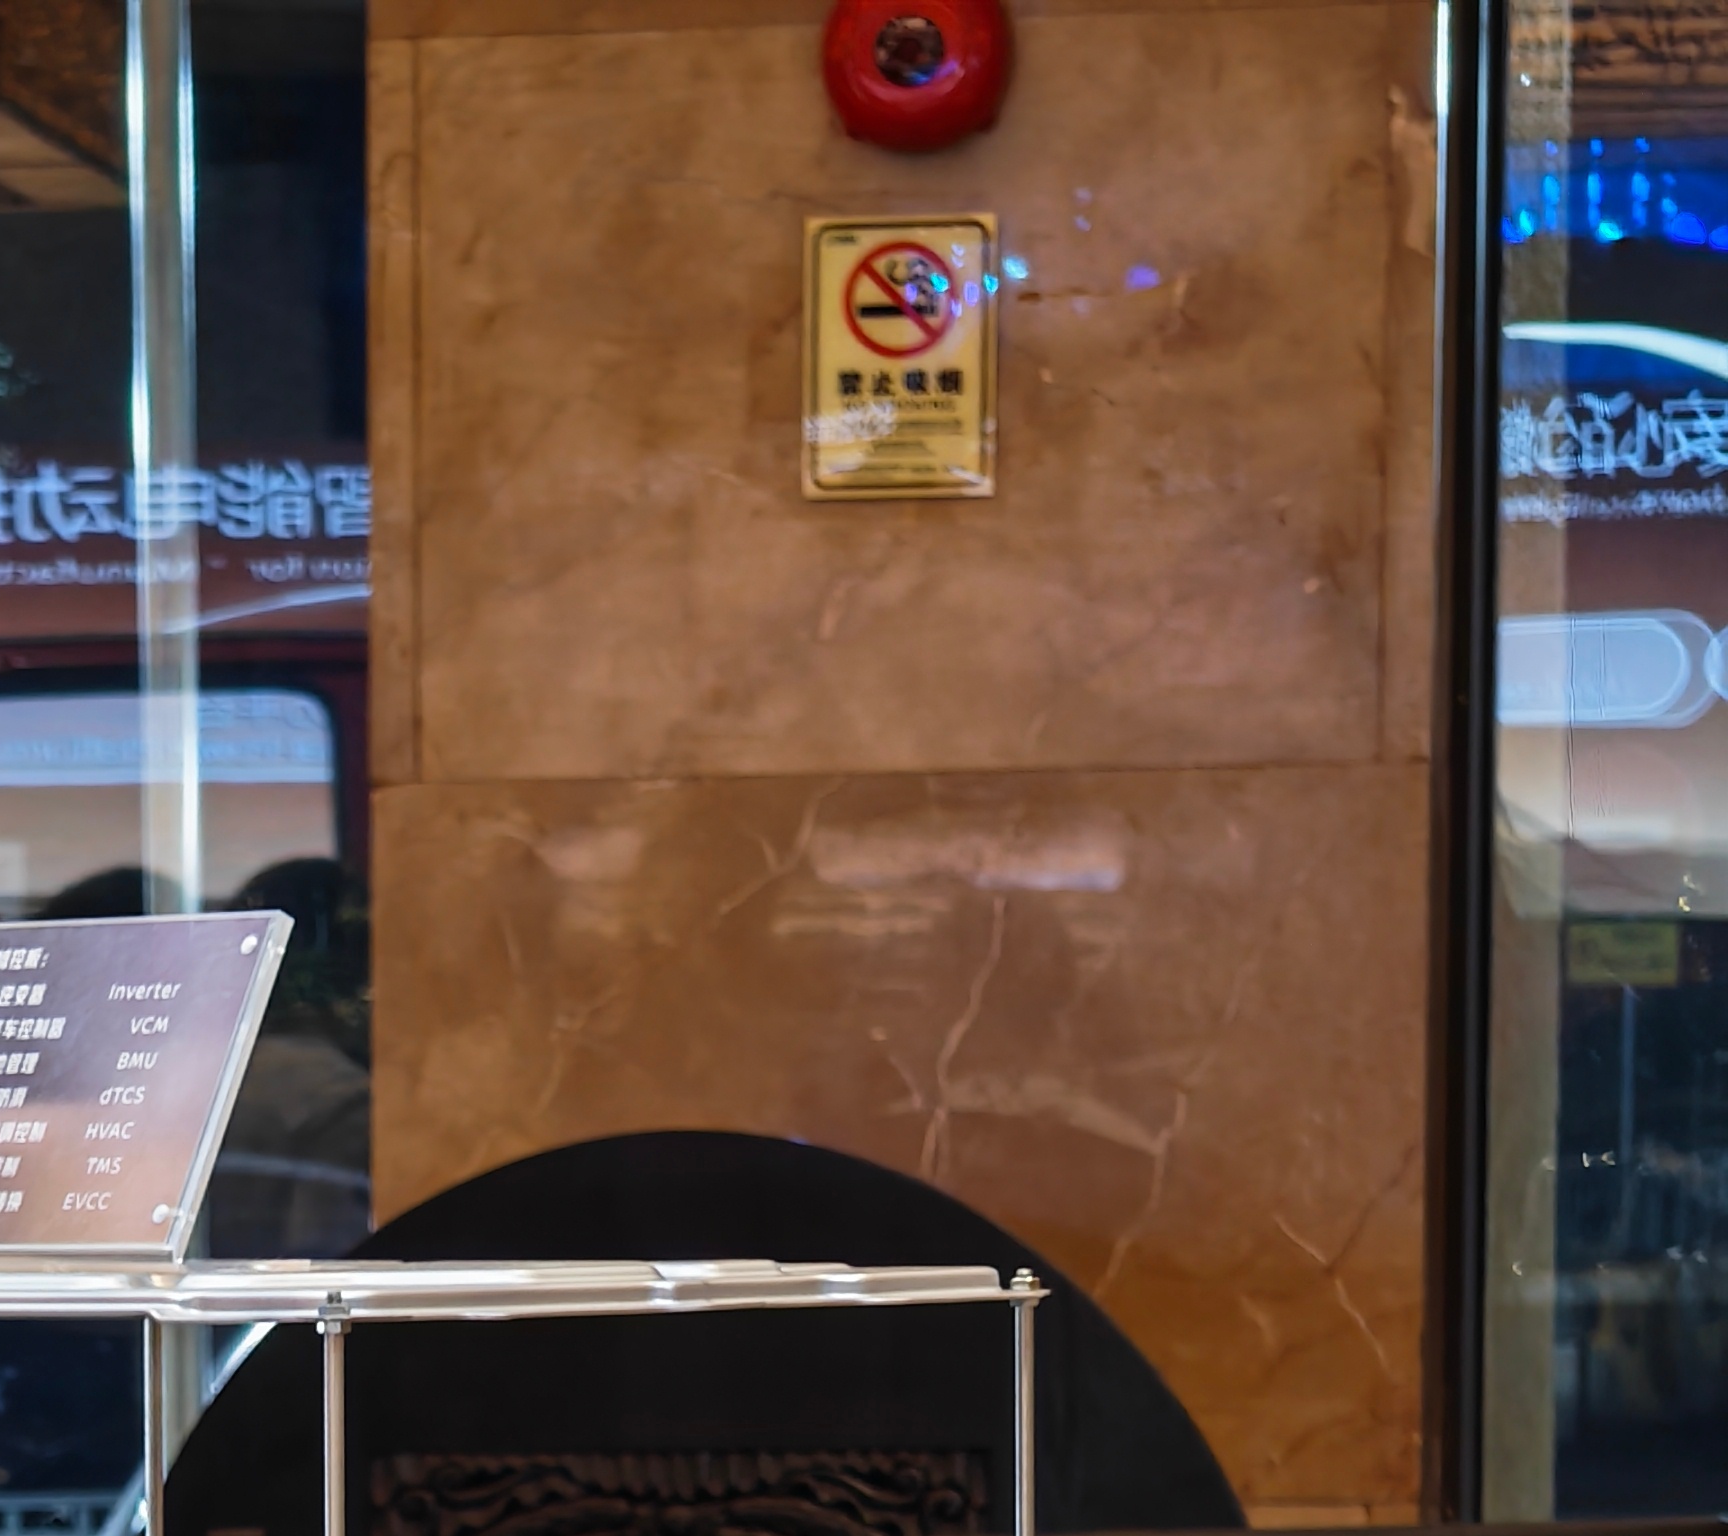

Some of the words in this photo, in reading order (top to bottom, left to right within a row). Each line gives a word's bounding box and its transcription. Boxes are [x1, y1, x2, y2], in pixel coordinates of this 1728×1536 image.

[108, 980, 181, 1002] Inverter
[129, 1016, 169, 1035] VCM
[116, 1051, 159, 1070] BMU
[99, 1086, 146, 1105] dTCS
[85, 1121, 134, 1141] HVAC
[86, 1156, 122, 1176] TMS
[61, 1192, 112, 1212] EVCC
